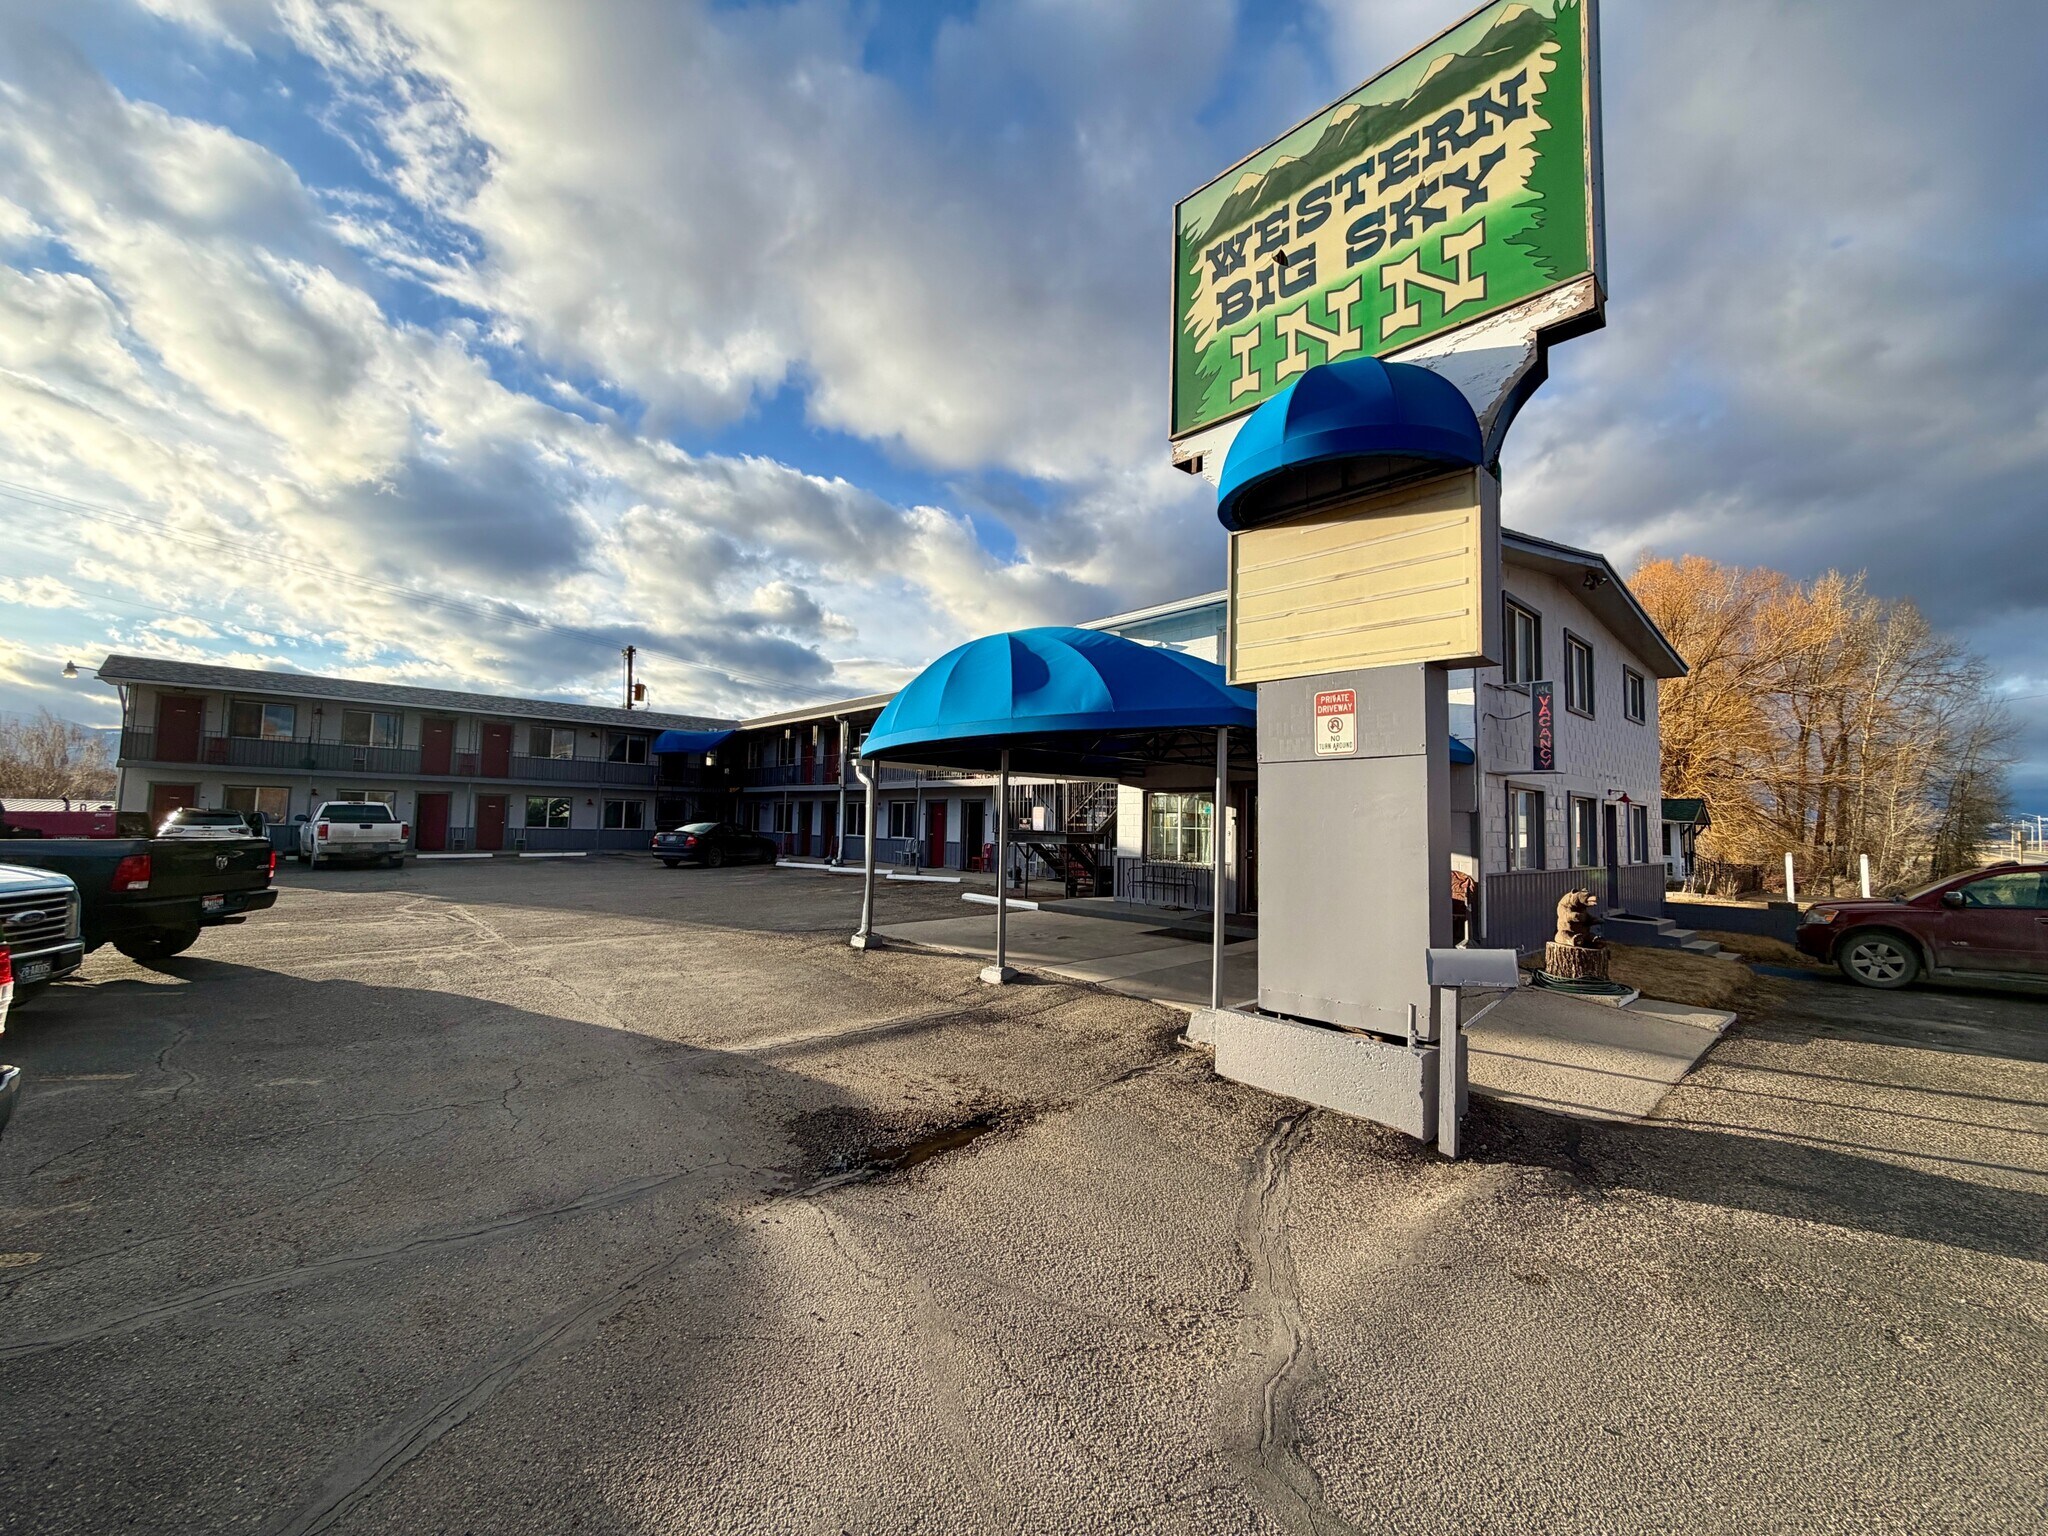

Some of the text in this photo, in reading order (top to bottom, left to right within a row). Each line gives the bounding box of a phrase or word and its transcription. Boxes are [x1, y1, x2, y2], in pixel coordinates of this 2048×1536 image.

[1206, 68, 1528, 284] WESTERN
[1216, 142, 1506, 332] BIG SKY
[1230, 217, 1486, 402] INN
[1317, 703, 1353, 714] DRIVEWAY
[1320, 693, 1350, 704] PRIVATE
[1538, 695, 1552, 768] VACANCY
[1332, 741, 1353, 750] AROUND
